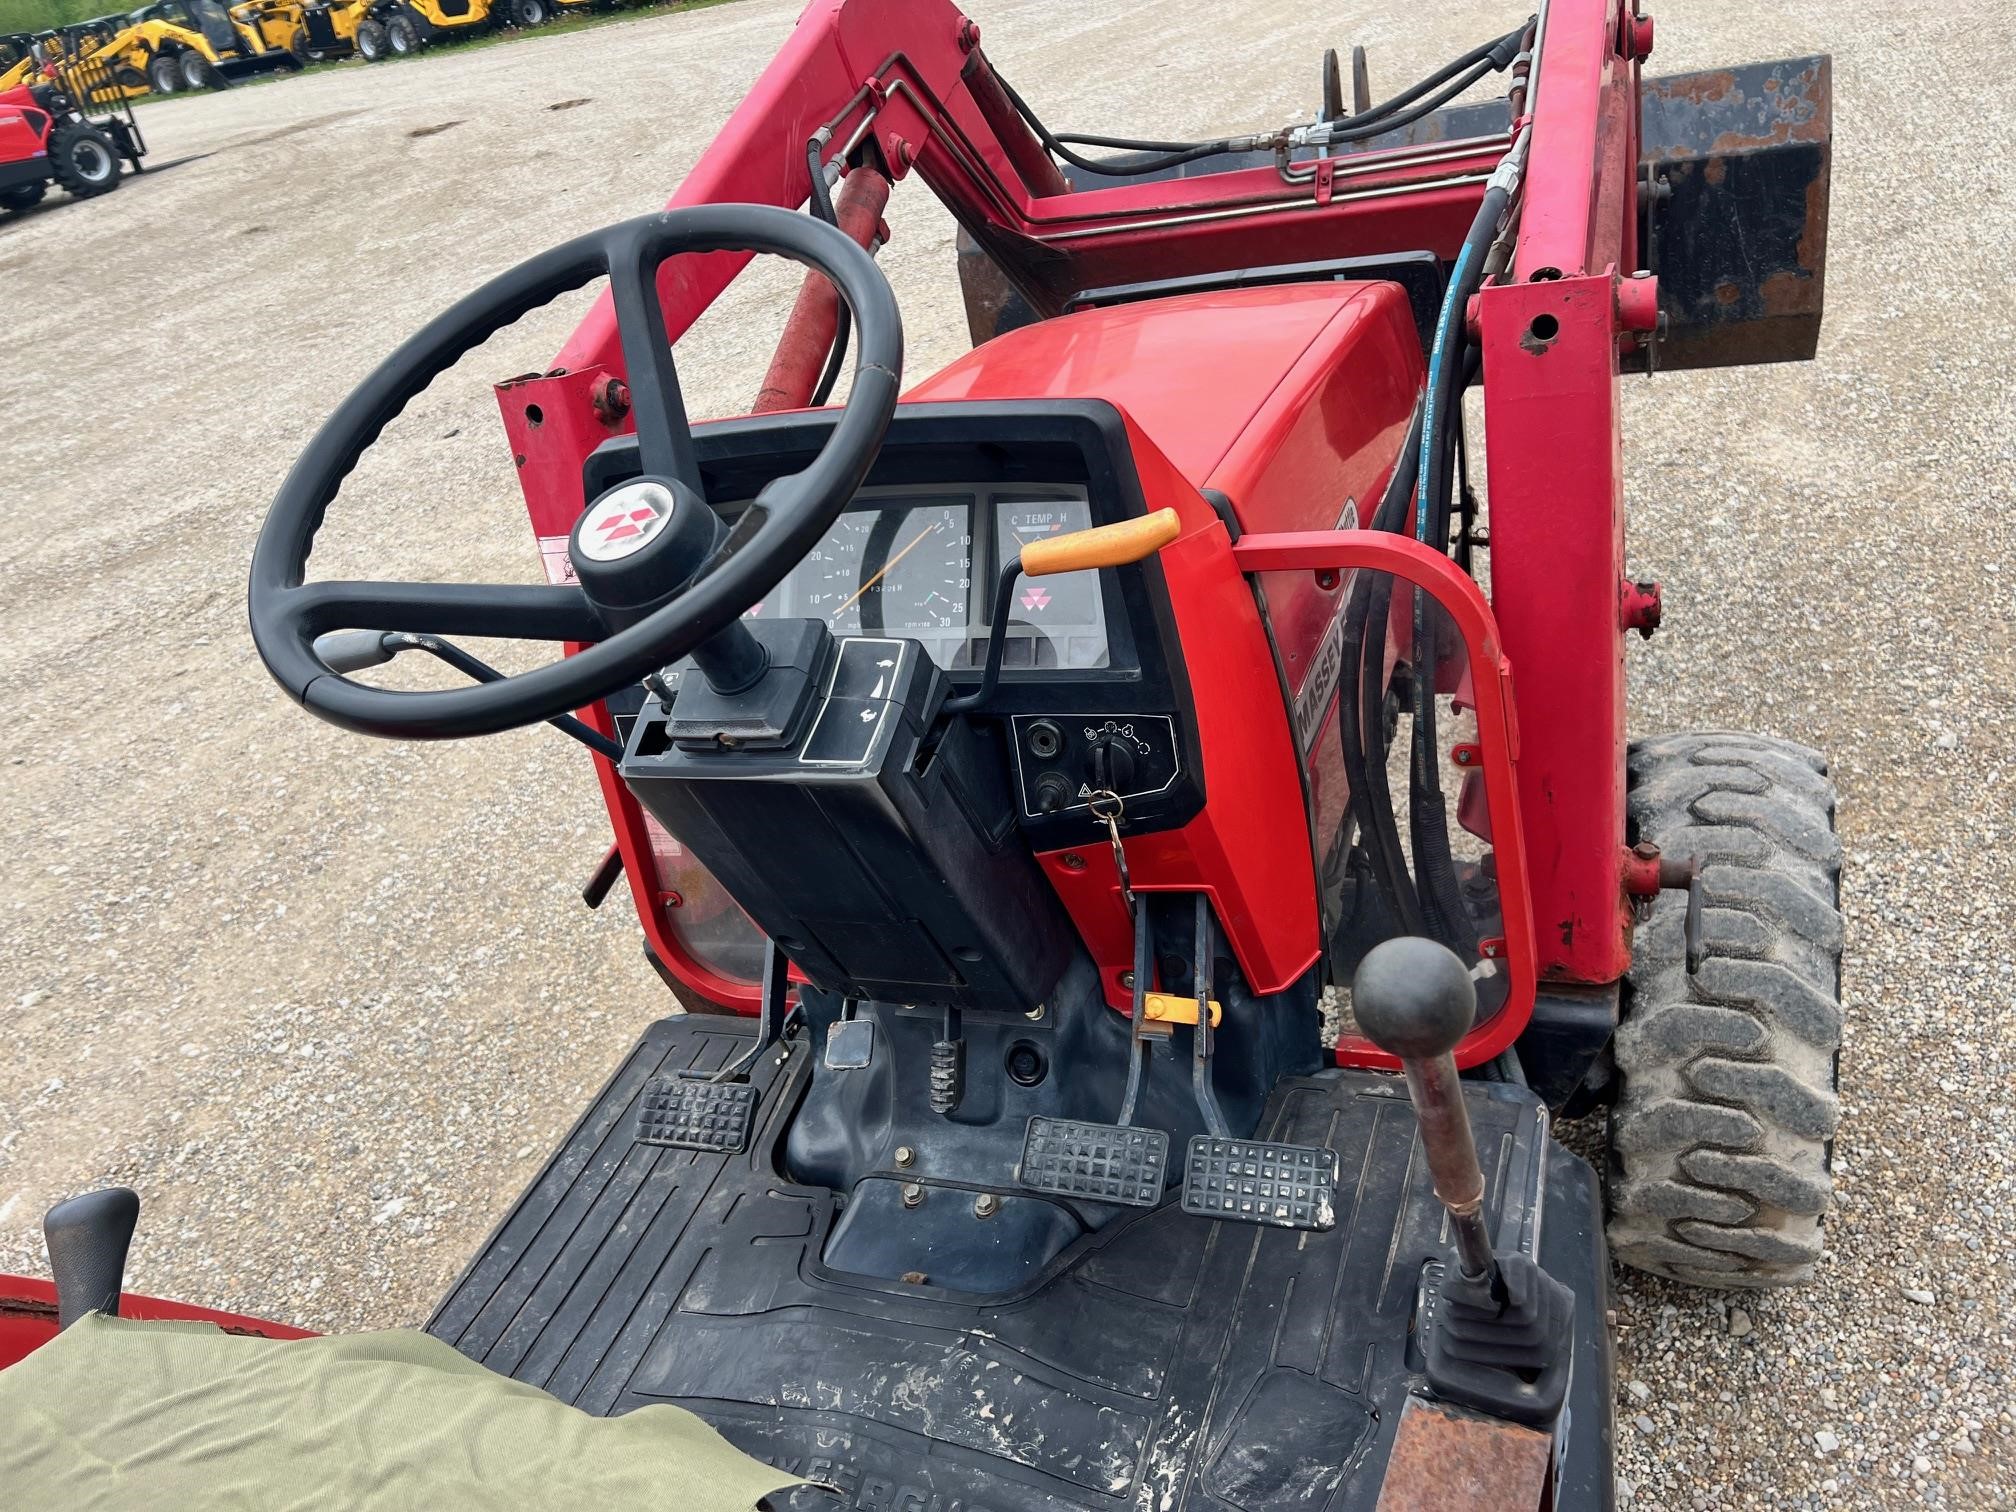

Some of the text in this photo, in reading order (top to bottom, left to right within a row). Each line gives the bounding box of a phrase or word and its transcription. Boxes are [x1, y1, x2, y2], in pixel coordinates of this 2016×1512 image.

[944, 510, 949, 520] 0
[1011, 512, 1067, 525] C TEMP H
[949, 519, 954, 528] 5
[960, 536, 970, 545] 10
[811, 552, 821, 561] 20
[960, 559, 970, 568] 15
[959, 579, 970, 588] 20
[810, 595, 820, 604] 10
[953, 603, 963, 613] 25
[829, 619, 834, 629] 0
[847, 622, 861, 630] mph
[939, 617, 950, 627] 30
[1297, 628, 1341, 738] MASSEY
